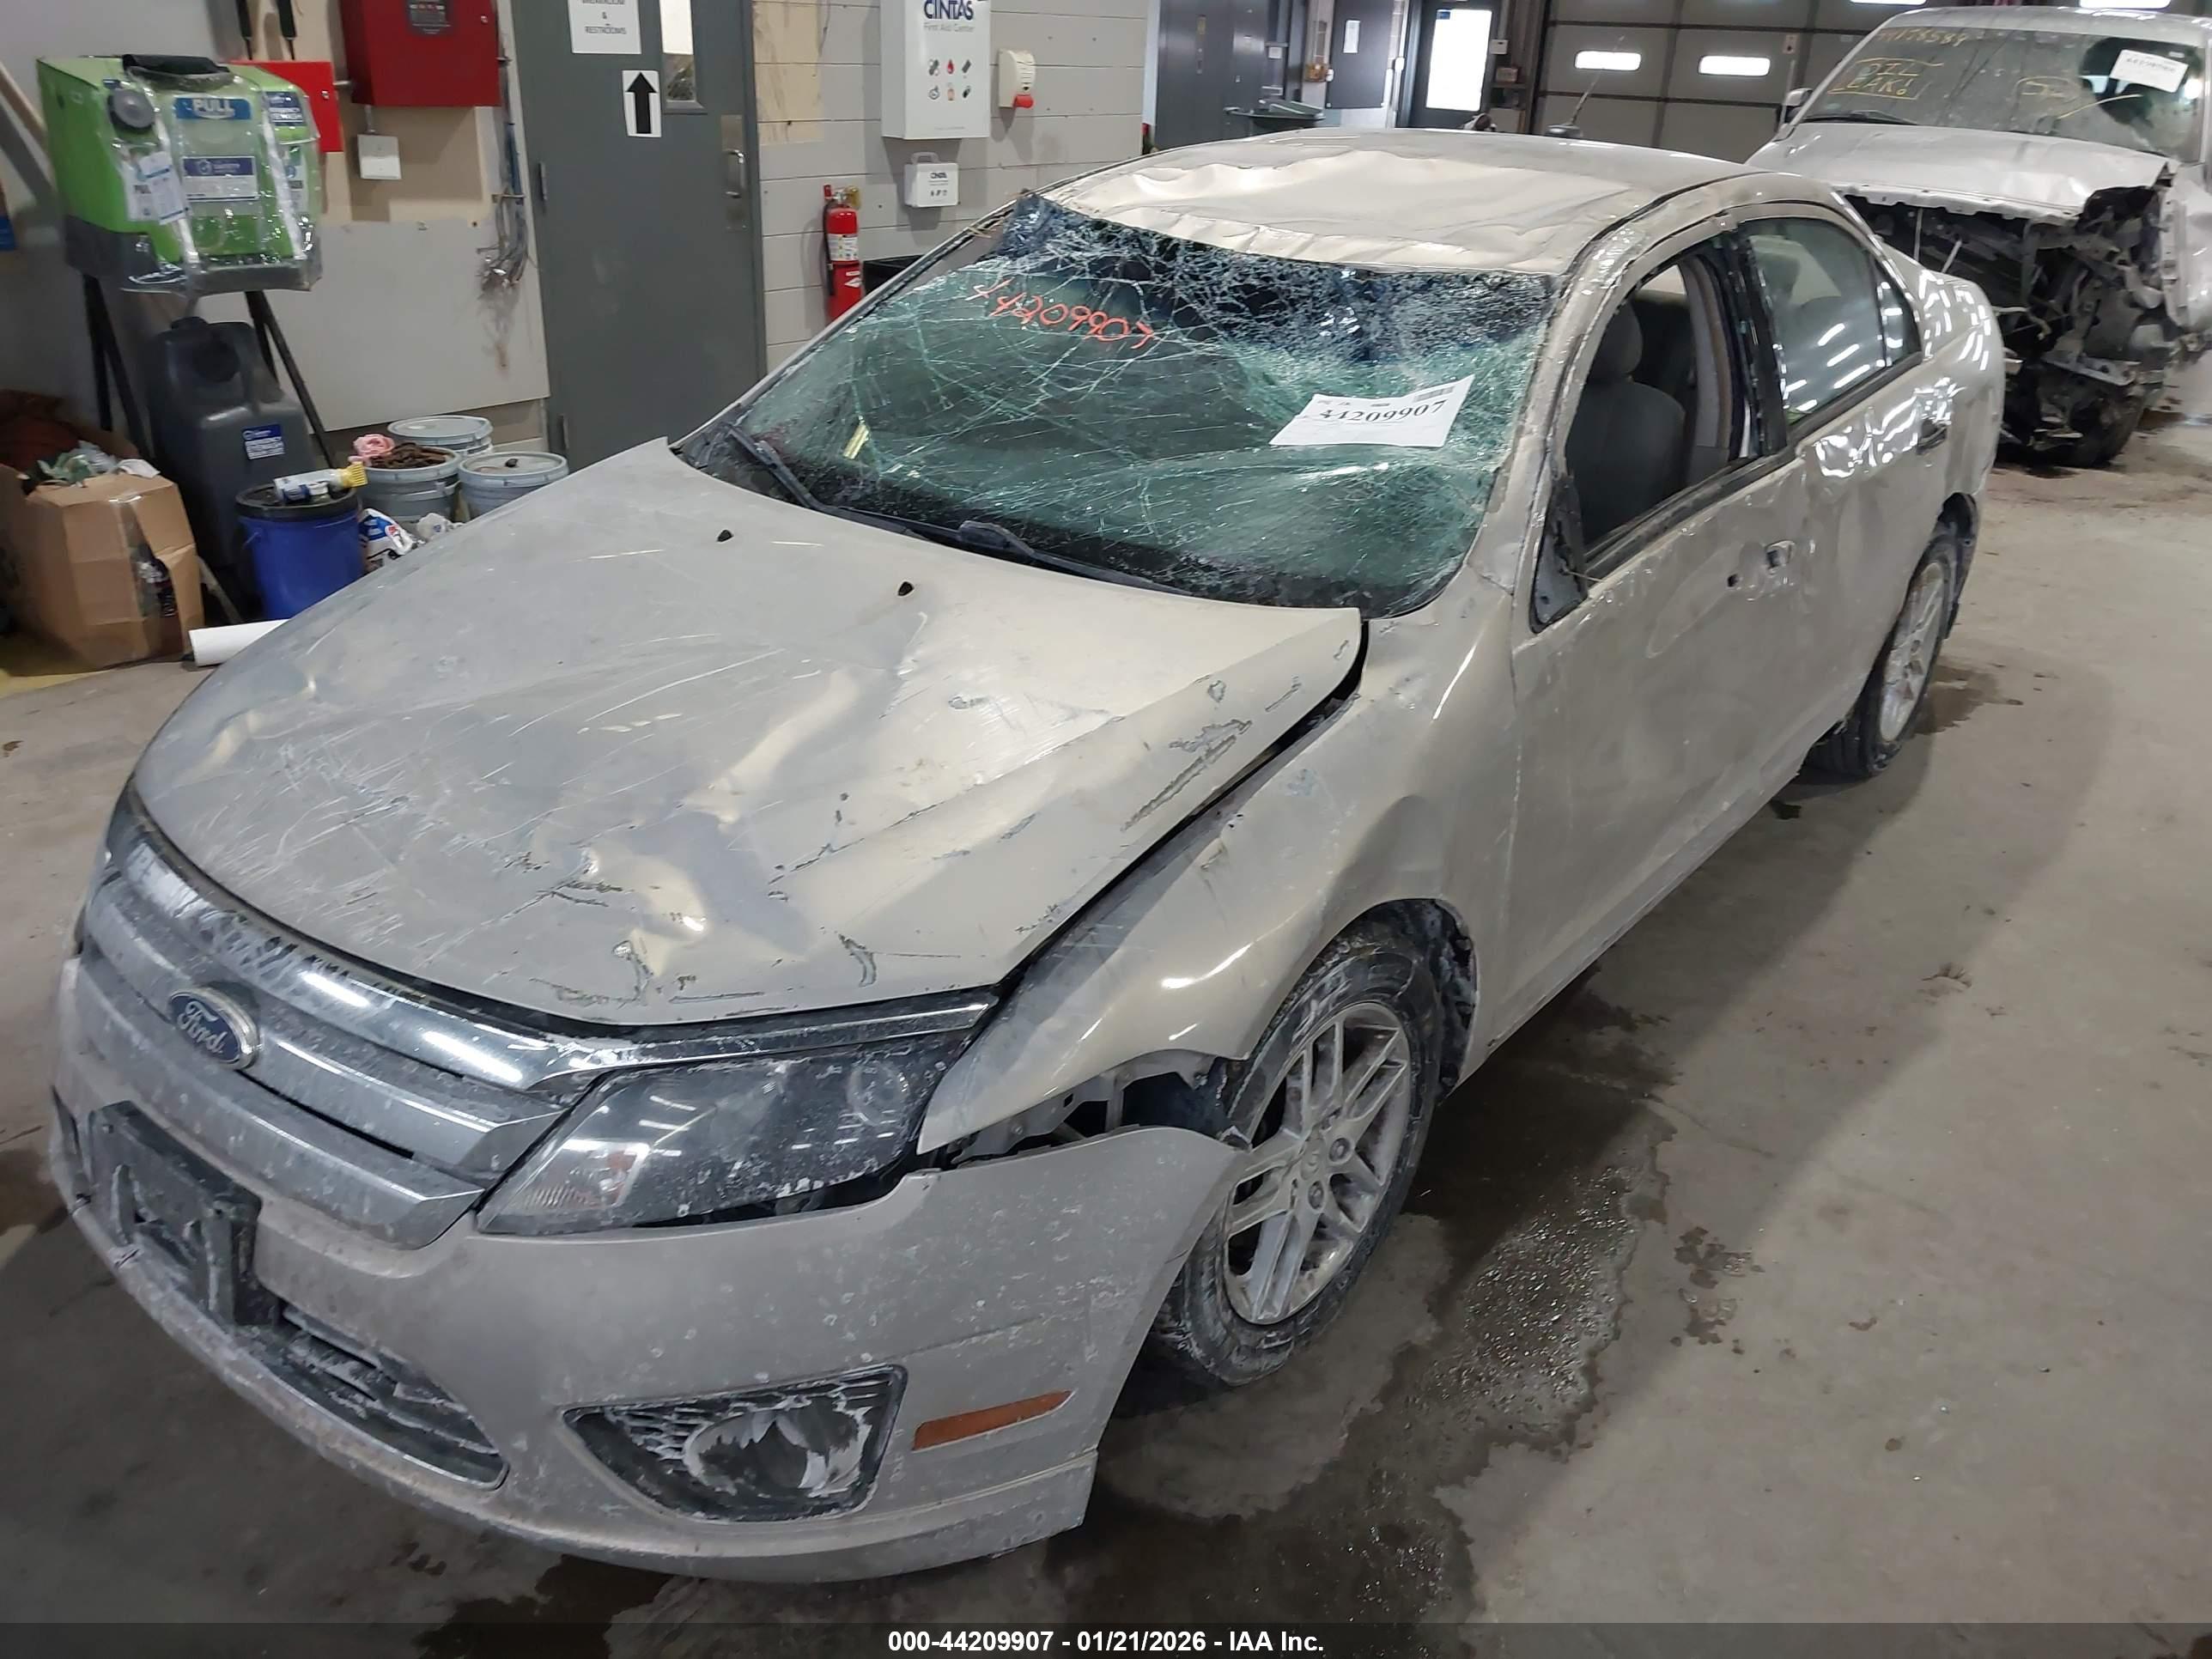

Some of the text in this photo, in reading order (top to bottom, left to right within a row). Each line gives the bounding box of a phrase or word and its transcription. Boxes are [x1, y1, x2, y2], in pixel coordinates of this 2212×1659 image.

[924, 0, 974, 20] CINTAS
[192, 99, 235, 116] PULL
[1318, 398, 1449, 422] 44209907
[177, 1000, 227, 1053] Ford
